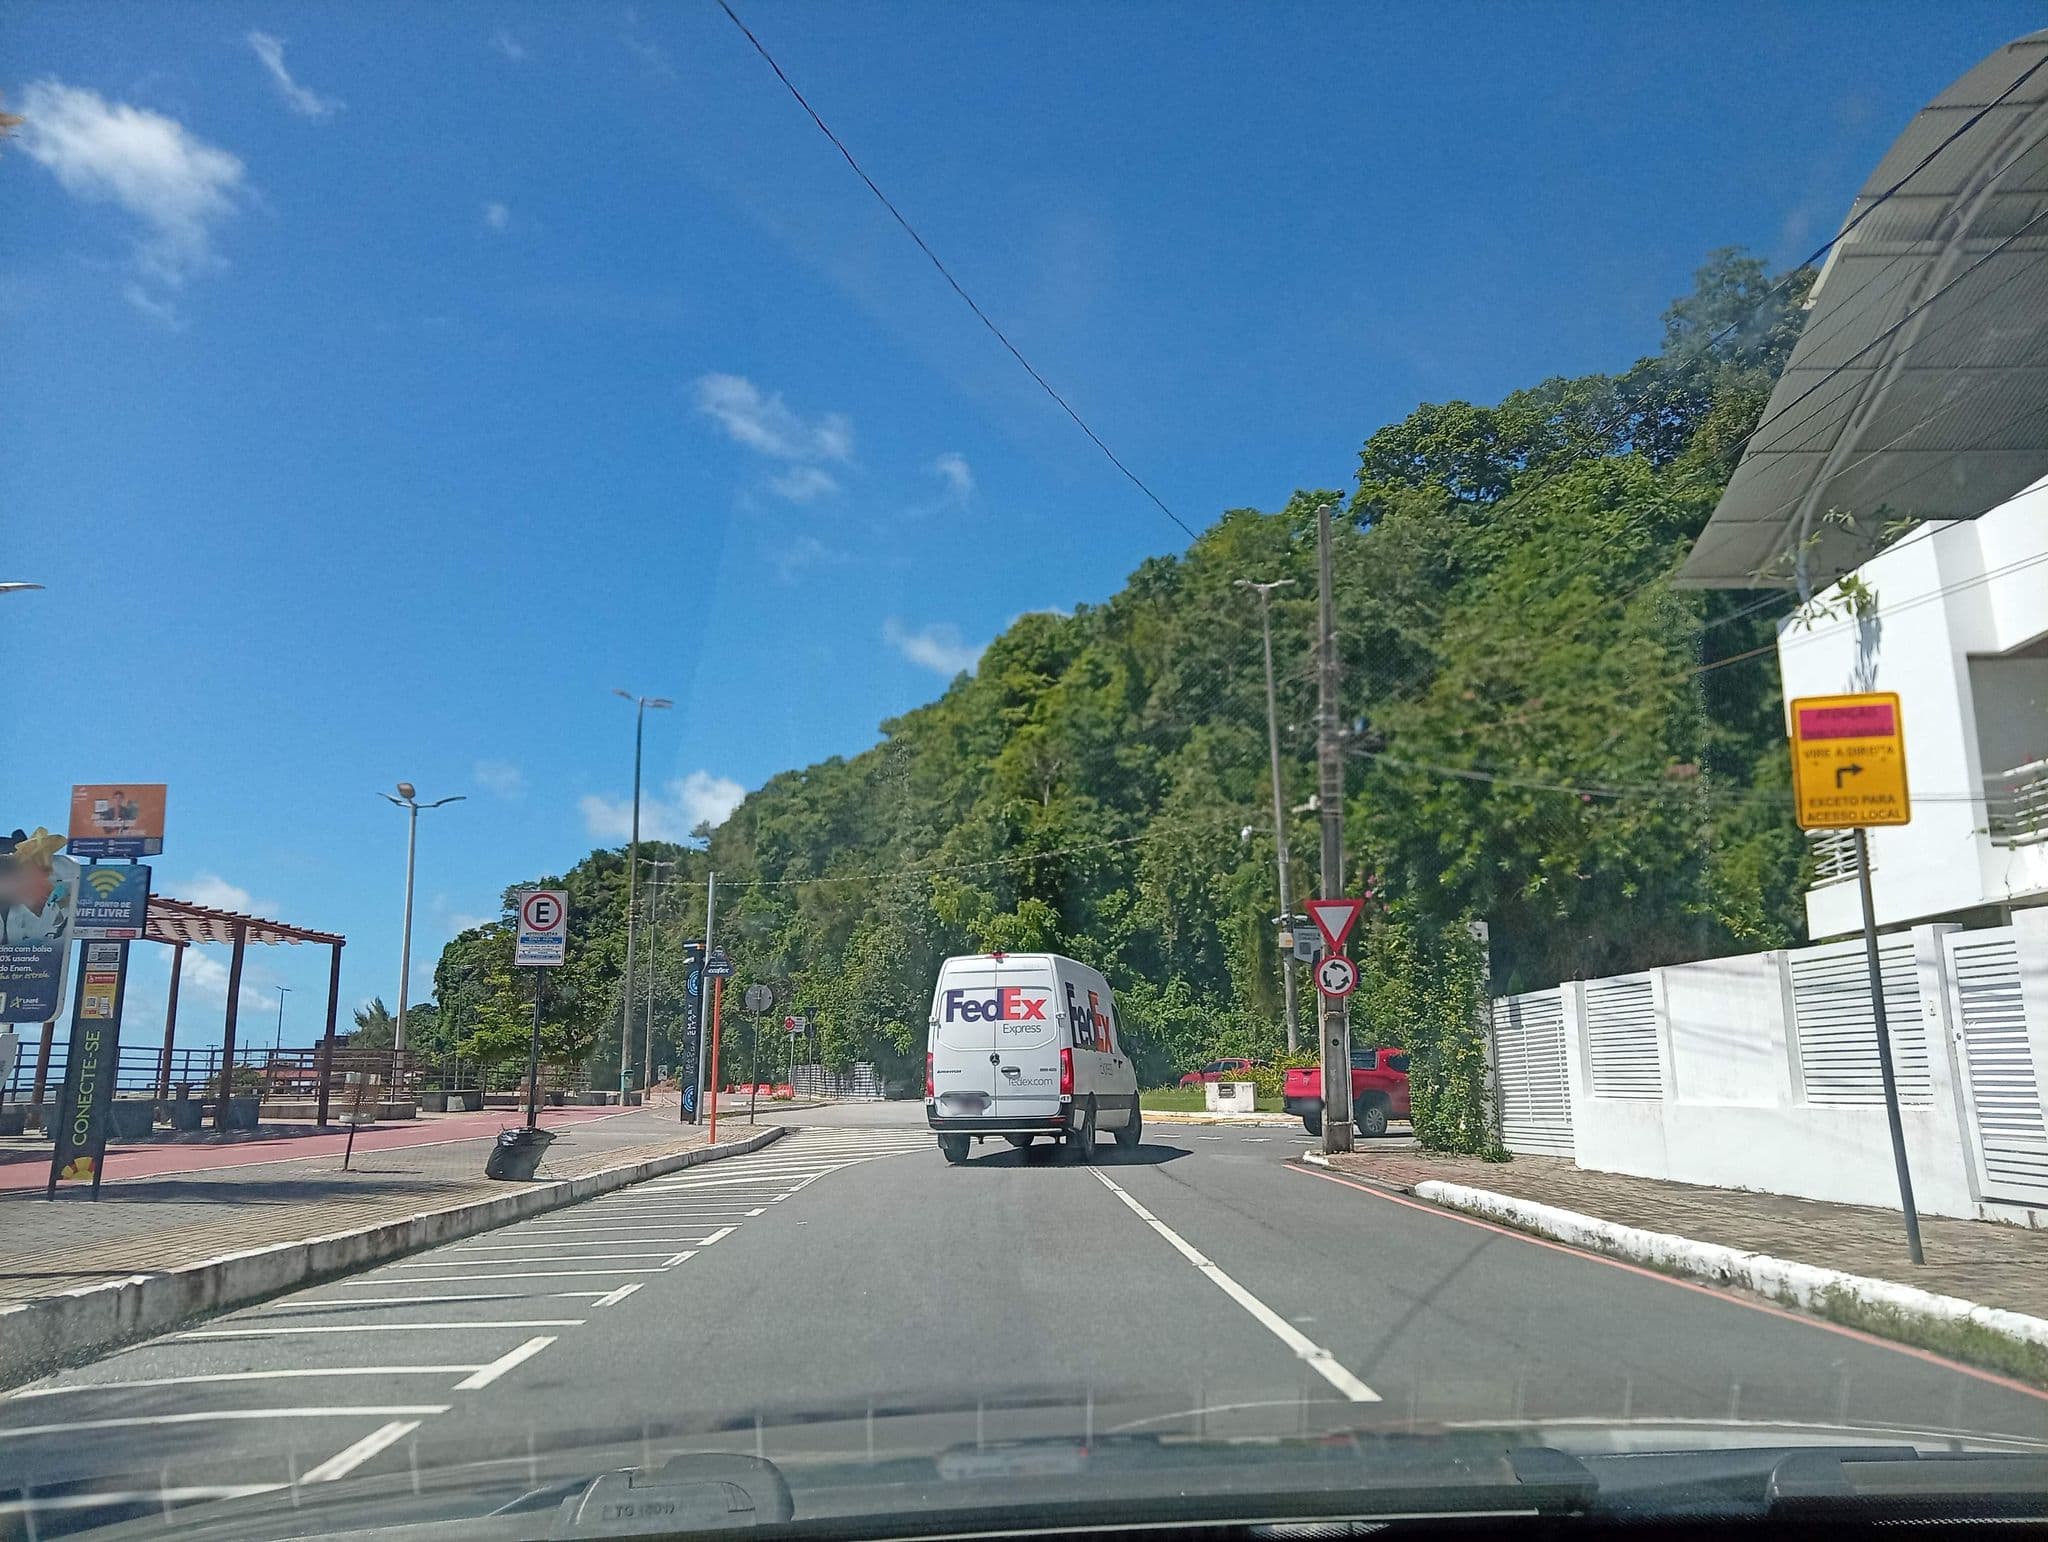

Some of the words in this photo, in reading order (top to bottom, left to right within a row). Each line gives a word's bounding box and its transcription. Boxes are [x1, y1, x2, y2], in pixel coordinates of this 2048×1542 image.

[1809, 795, 1859, 807] EXCETO
[1862, 793, 1896, 804] PARA
[1860, 808, 1901, 820] LOCAL
[97, 908, 131, 918] LIVRE
[535, 902, 550, 923] E
[12, 954, 40, 962] usando
[945, 987, 1047, 1023] FedEx
[1065, 981, 1114, 1054] FedEx
[1002, 1023, 1042, 1035] Express
[72, 1030, 100, 1146] CONECTE-SE
[1008, 1077, 1053, 1087] fedex.com
